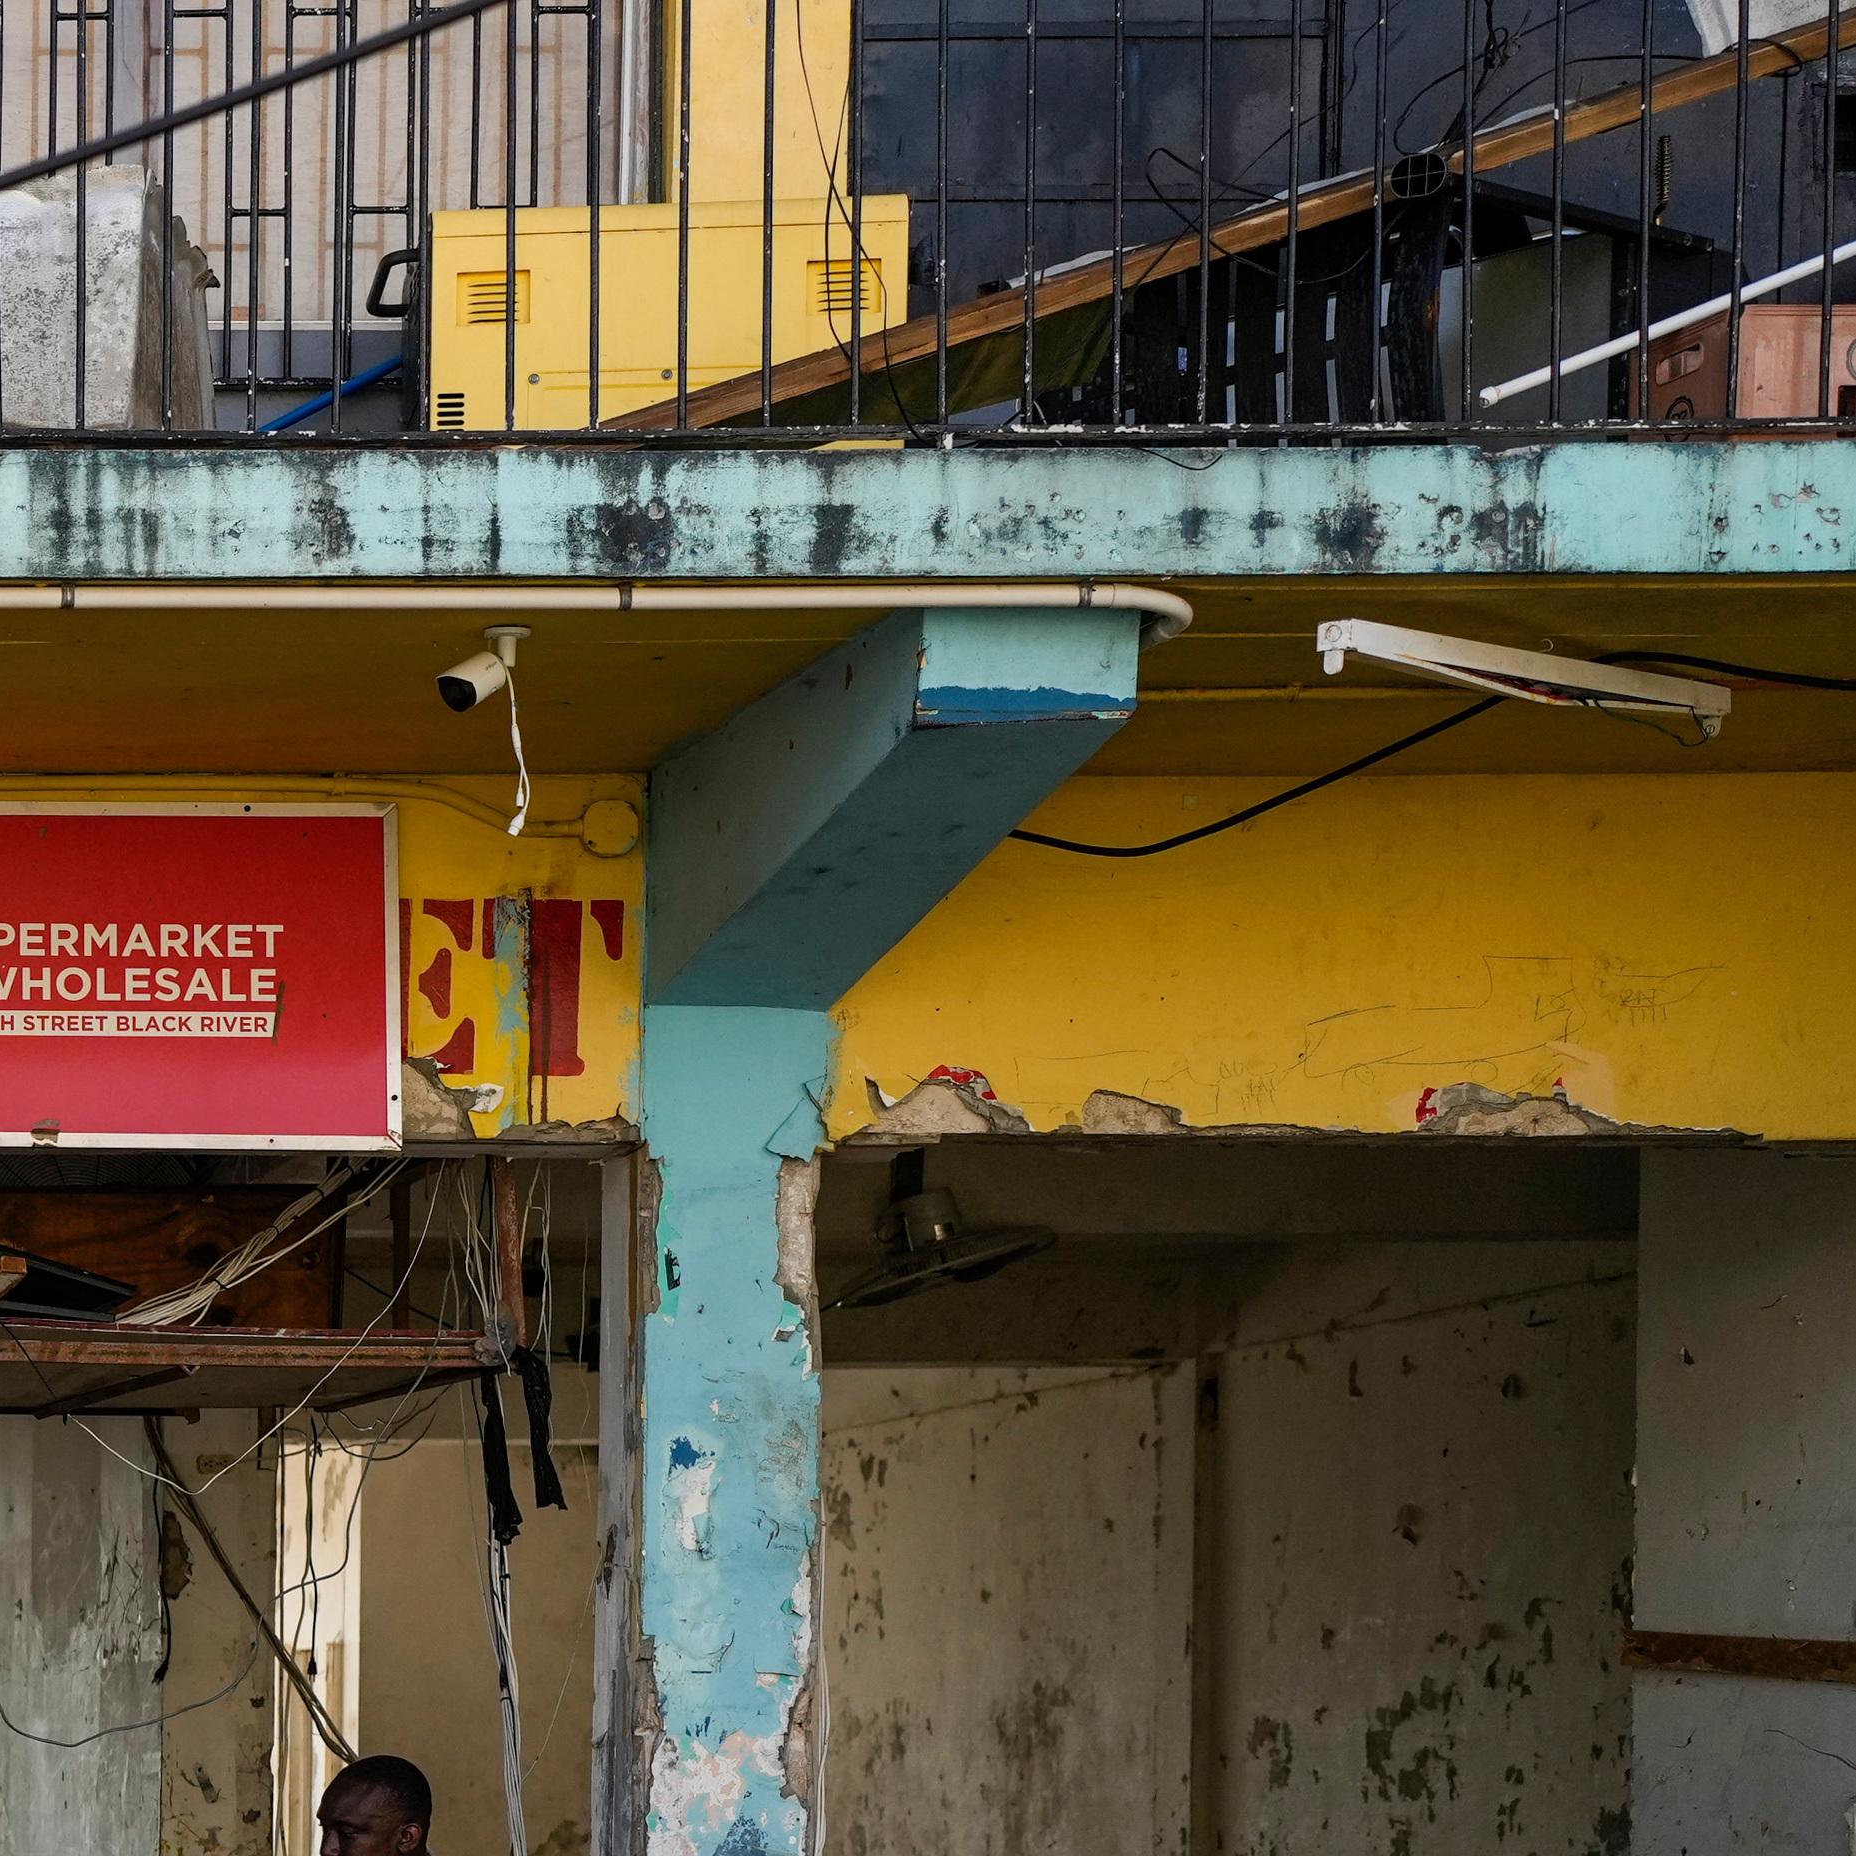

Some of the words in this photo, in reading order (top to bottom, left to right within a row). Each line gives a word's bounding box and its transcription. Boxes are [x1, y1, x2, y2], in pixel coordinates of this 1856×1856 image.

[23, 1014, 109, 1032] STREET
[116, 1015, 193, 1032] BLACK
[200, 1016, 268, 1033] RIVER
